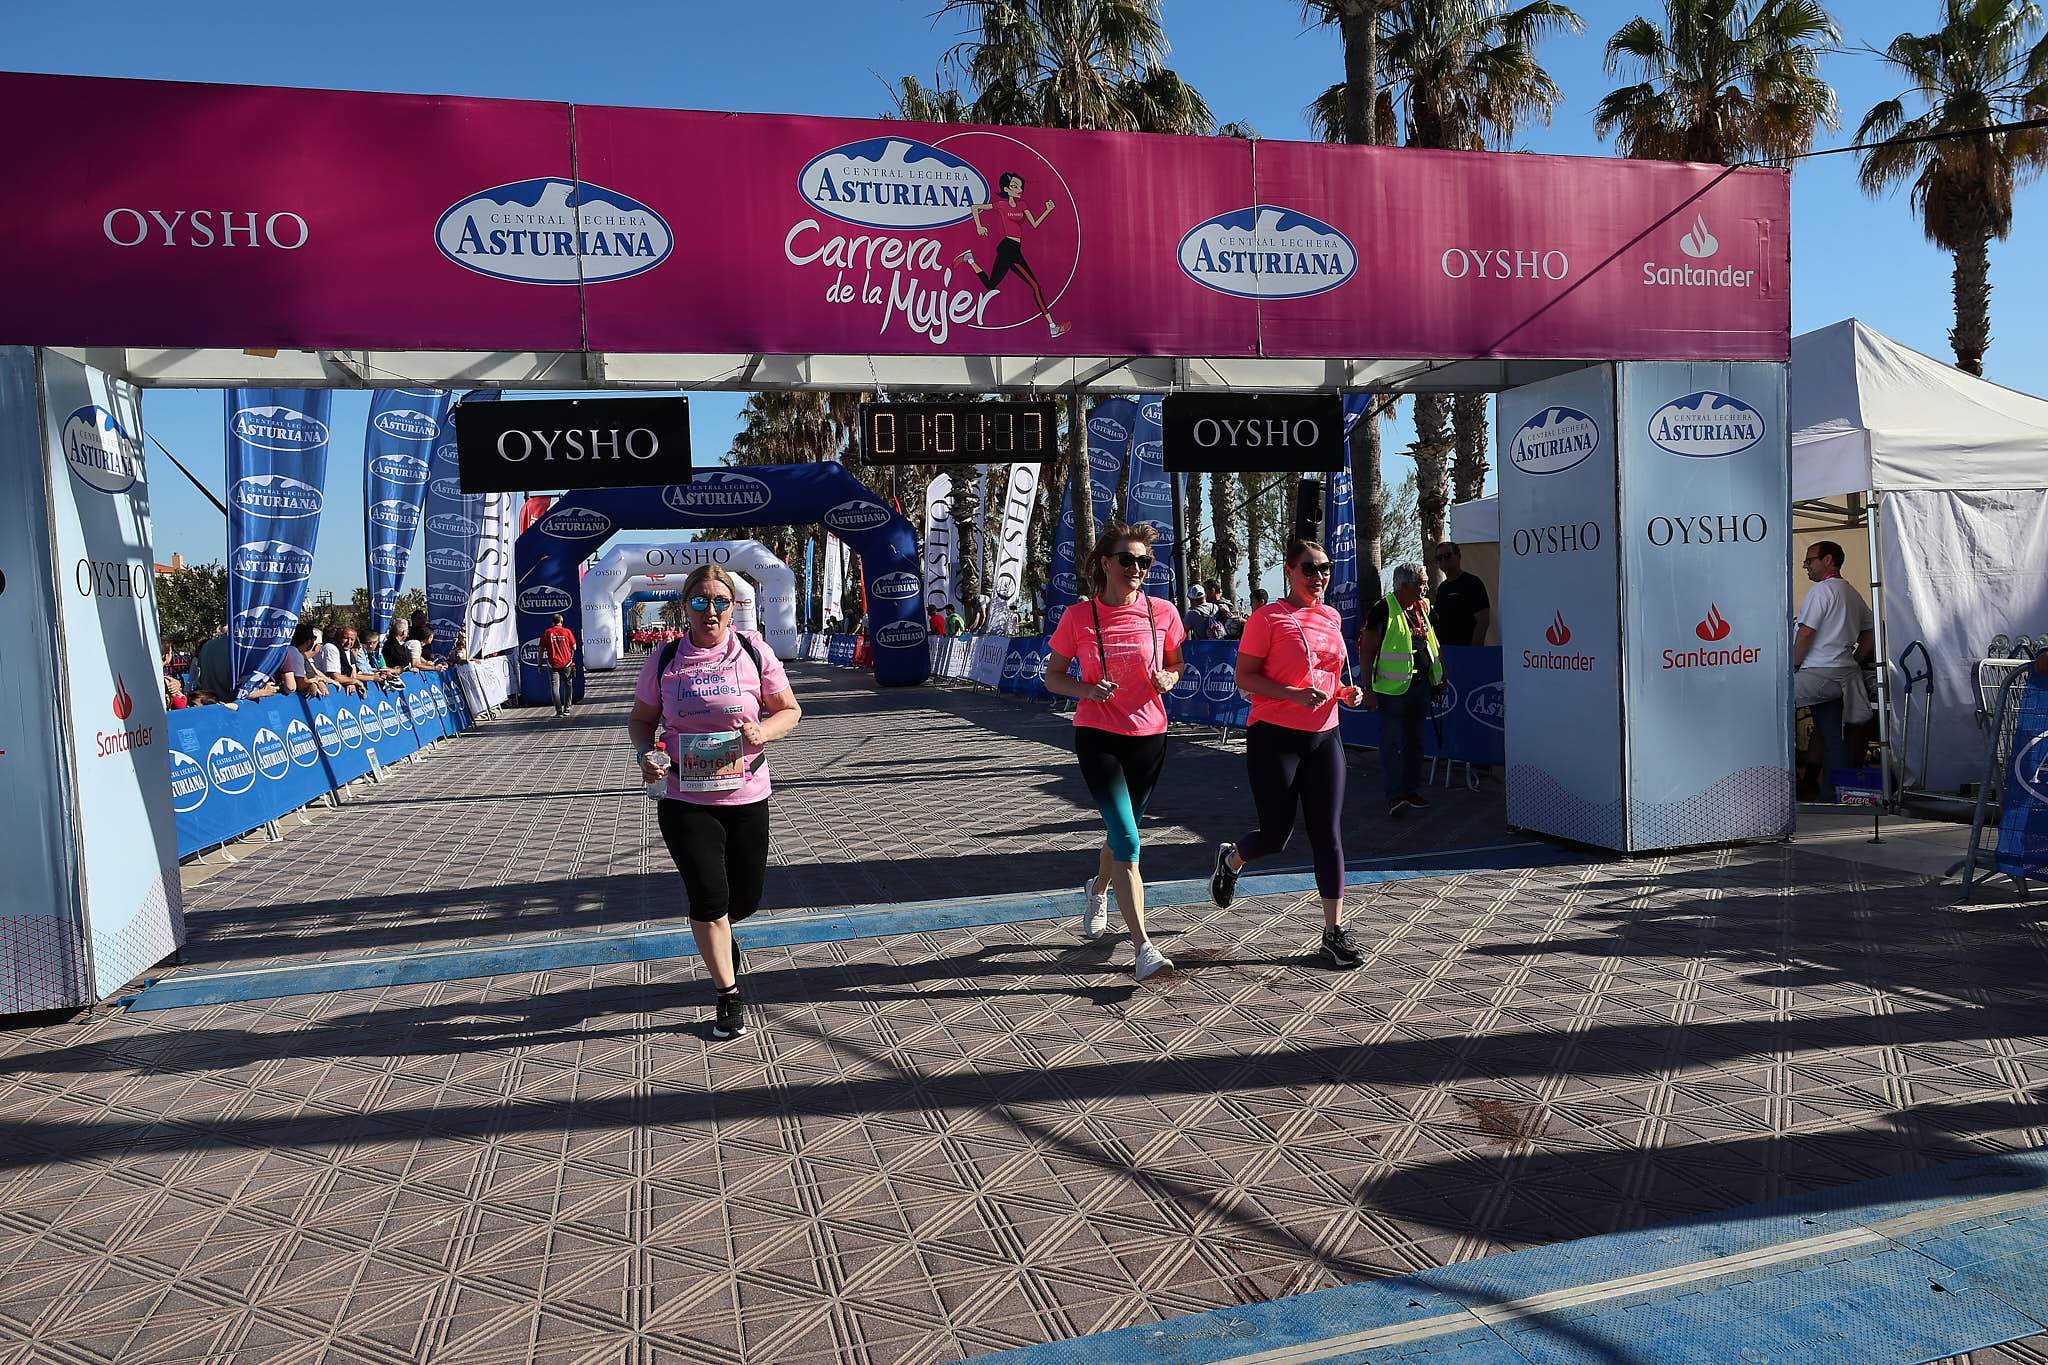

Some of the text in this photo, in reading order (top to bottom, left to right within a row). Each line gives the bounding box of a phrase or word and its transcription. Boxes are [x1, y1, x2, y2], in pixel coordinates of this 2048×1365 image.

[843, 167, 969, 181] CENTRAL LECHERA
[814, 167, 976, 207] ASTURIANA
[103, 208, 309, 250] OYSHO
[490, 213, 566, 225] CENTRAL
[455, 215, 656, 257] ASTURIANA
[784, 219, 942, 272] Carrera
[1219, 237, 1338, 249] CENTRAL LECHERA
[1192, 237, 1344, 276] ASTURIANA
[1441, 248, 1569, 281] OYSHO
[1643, 262, 1754, 289] Santander
[826, 268, 1001, 344] de la Mujer
[236, 416, 322, 442] ASTURIANA
[1657, 416, 1756, 442] ASTURIANA
[1674, 414, 1752, 422] CENTRAL LECHERA
[875, 413, 1042, 453] 01:01:17
[1193, 419, 1319, 447] OYSHO
[1527, 423, 1589, 441] CENTRAL LECHERA
[70, 429, 134, 477] ASTURIANA
[497, 428, 659, 462] OYSHO
[1516, 432, 1592, 463] ASTURIANA
[236, 486, 318, 510] ASTURIANA
[671, 485, 764, 505] ASTURIANA
[1135, 487, 1172, 501] ASTURIA
[372, 507, 418, 524] ASTURIAN
[430, 519, 475, 534] ASTURIANA
[544, 520, 605, 531] ASTURIANA
[830, 511, 887, 525] ASTURIANA
[996, 466, 1034, 600] OYSHO
[1513, 521, 1601, 556] OYSHO
[1647, 513, 1767, 546] OYSHO
[235, 553, 310, 575] ASTURIANA
[646, 547, 731, 567] OYSHO
[927, 499, 951, 612] OYSHO
[76, 559, 147, 600] OYSHO
[874, 579, 920, 594] ASTURIANA
[430, 592, 466, 603] STURIANA
[520, 596, 569, 609] ASTURIANA
[879, 630, 925, 643] ASTURIANA
[1523, 650, 1595, 671] Santander
[1662, 645, 1761, 669] Santander
[682, 685, 736, 698] incluid@s
[688, 674, 726, 686] Tod@s
[96, 723, 152, 757] Santander
[212, 760, 254, 785] ASTURIANA
[172, 774, 206, 798] TURIANA
